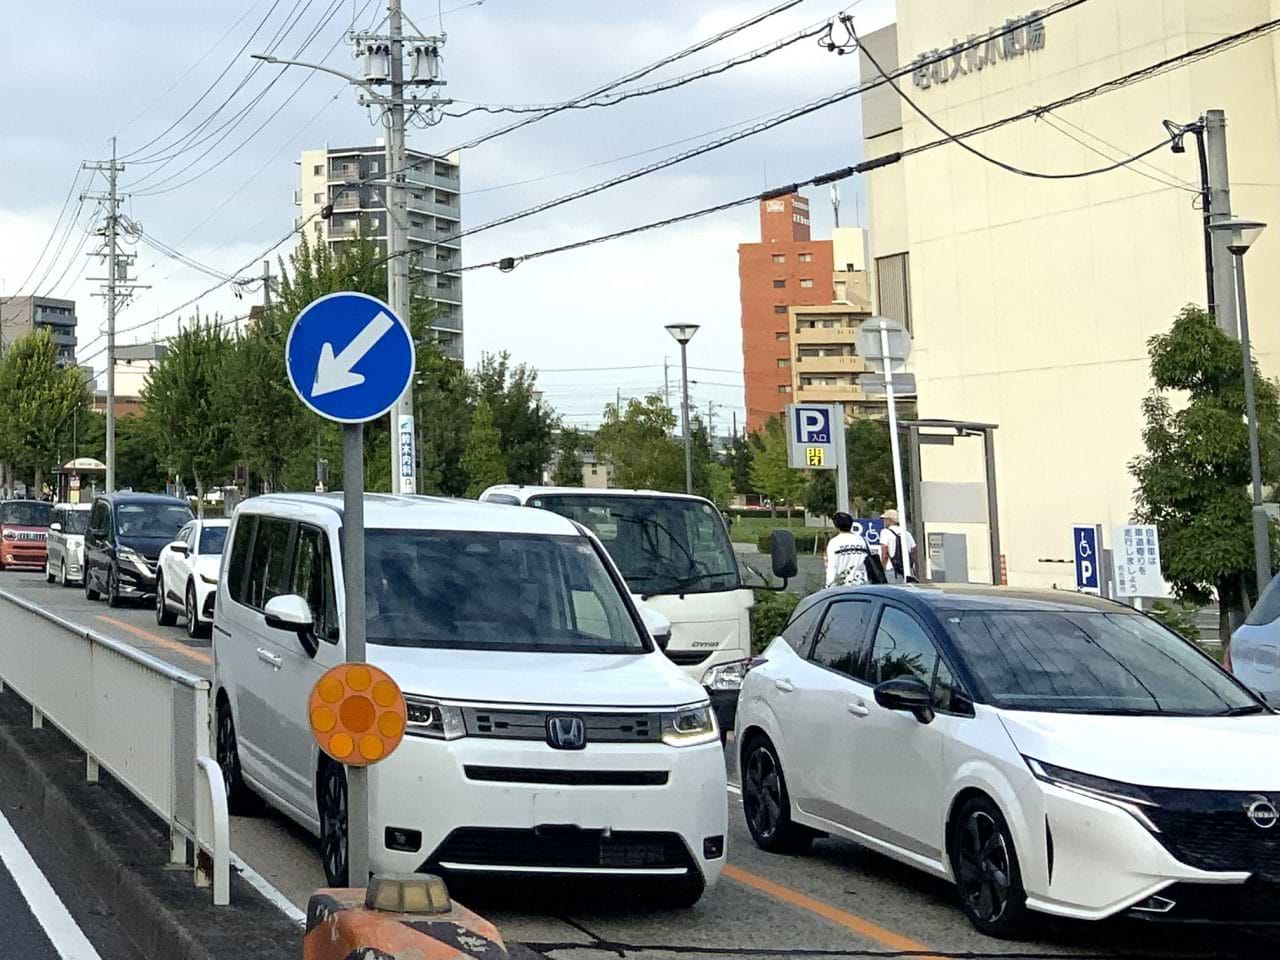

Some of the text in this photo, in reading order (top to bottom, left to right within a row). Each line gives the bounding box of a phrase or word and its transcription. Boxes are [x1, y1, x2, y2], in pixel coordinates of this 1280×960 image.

[800, 410, 825, 442] P
[812, 433, 827, 441] 入口
[400, 431, 413, 477] 鈴木内科
[1124, 528, 1138, 593] 走行しましょう
[1135, 528, 1147, 575] 車道寄りを
[1145, 528, 1157, 566] 自転車は
[1081, 560, 1092, 585] P
